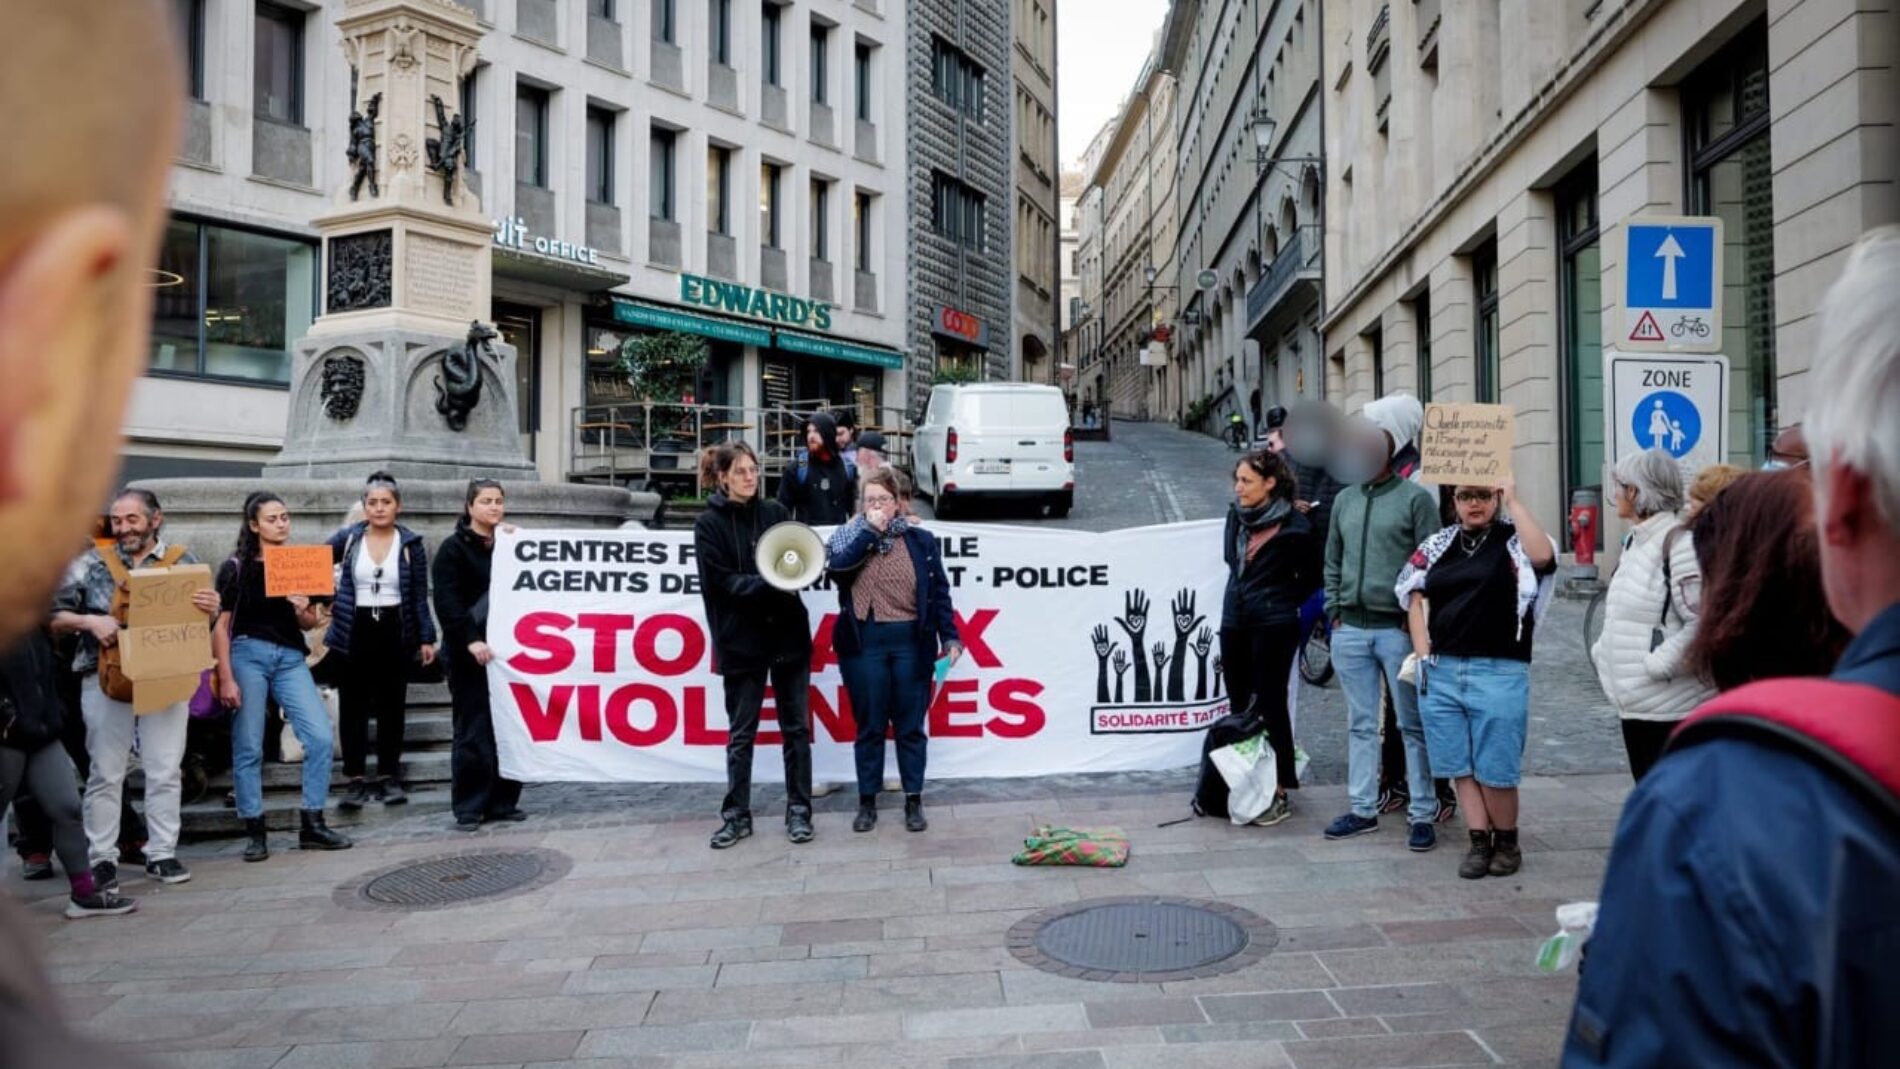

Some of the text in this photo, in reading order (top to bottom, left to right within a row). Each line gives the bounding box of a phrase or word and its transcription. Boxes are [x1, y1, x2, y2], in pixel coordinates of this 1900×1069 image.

[535, 236, 599, 264] OFFICE
[681, 273, 832, 330] EDWARD'S
[1642, 370, 1691, 388] ZONE
[515, 540, 668, 565] CENTRES
[512, 570, 649, 593] AGENTS
[992, 565, 1109, 588] POLICE
[134, 580, 197, 608] STOP
[507, 611, 723, 676] STO
[509, 678, 1046, 746] VIOLENES
[1098, 703, 1231, 727] SOLIDARITÉ TATTE
